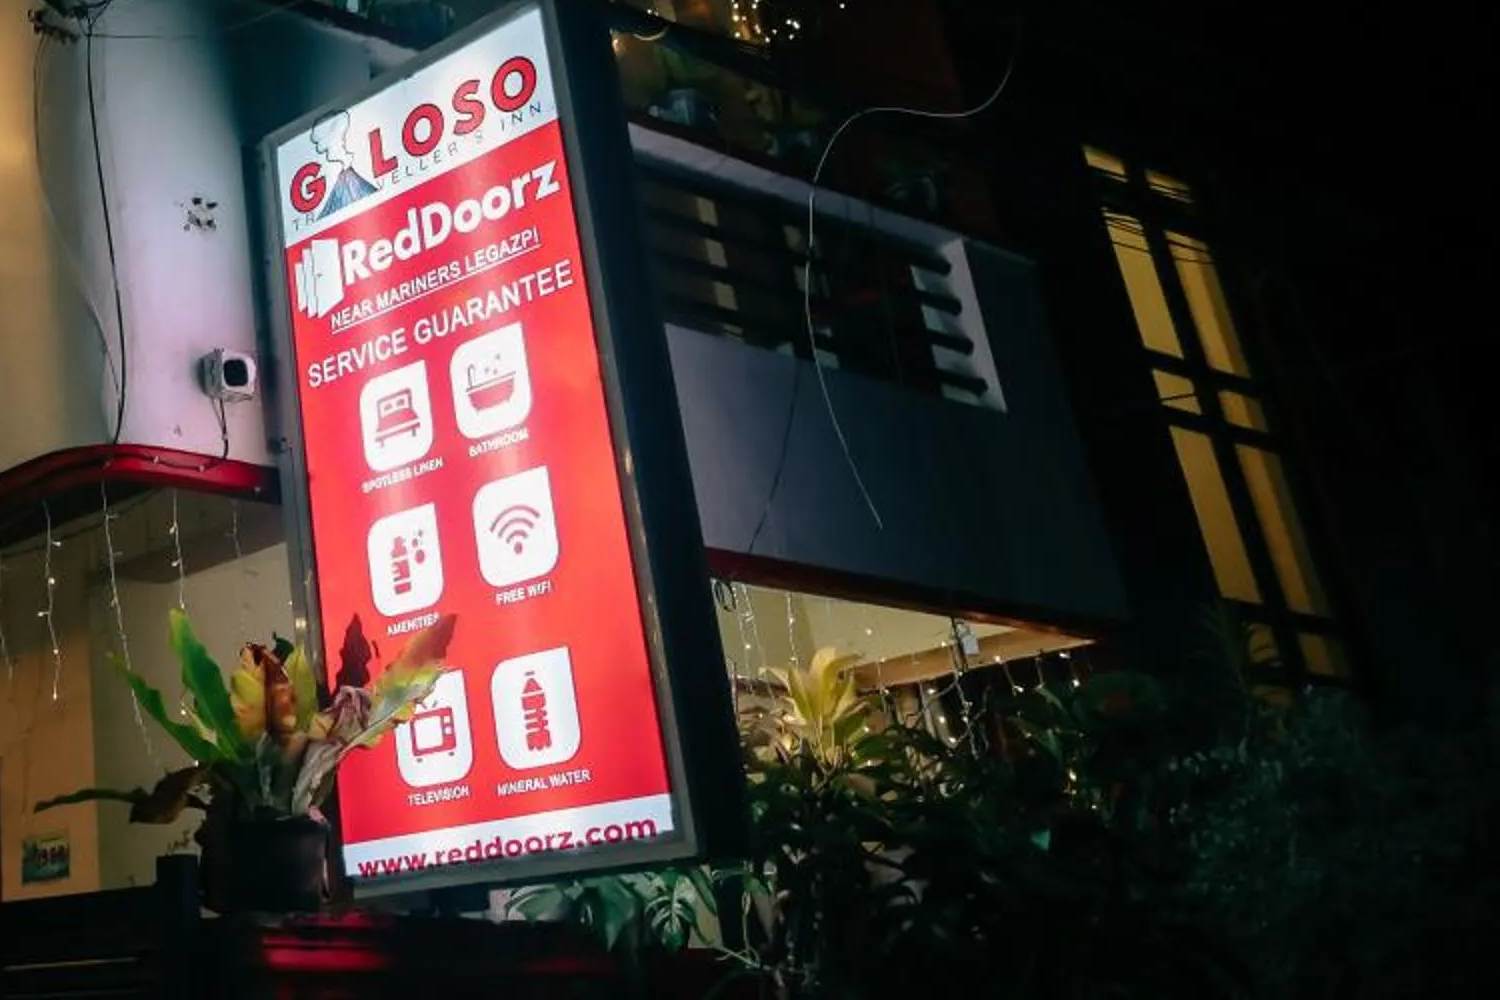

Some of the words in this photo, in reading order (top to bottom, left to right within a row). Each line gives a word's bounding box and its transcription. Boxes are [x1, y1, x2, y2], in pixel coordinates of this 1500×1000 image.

[292, 133, 484, 231] TRVELLER'S
[500, 102, 543, 133] INN
[342, 160, 561, 286] RedDoorz
[330, 302, 375, 329] NEAR
[375, 261, 462, 309] MARINERS
[465, 229, 540, 273] LEGAZPI
[307, 328, 409, 387] SERVICE
[413, 259, 575, 343] GUARANTEE
[413, 456, 444, 476] LINEN
[468, 427, 530, 458] BATHROOM
[494, 587, 526, 606] FREE
[407, 784, 470, 807] TELEVISION
[496, 776, 548, 797] MINERAL
[548, 768, 592, 788] WATER
[357, 814, 657, 879] www.reddoorz.com
